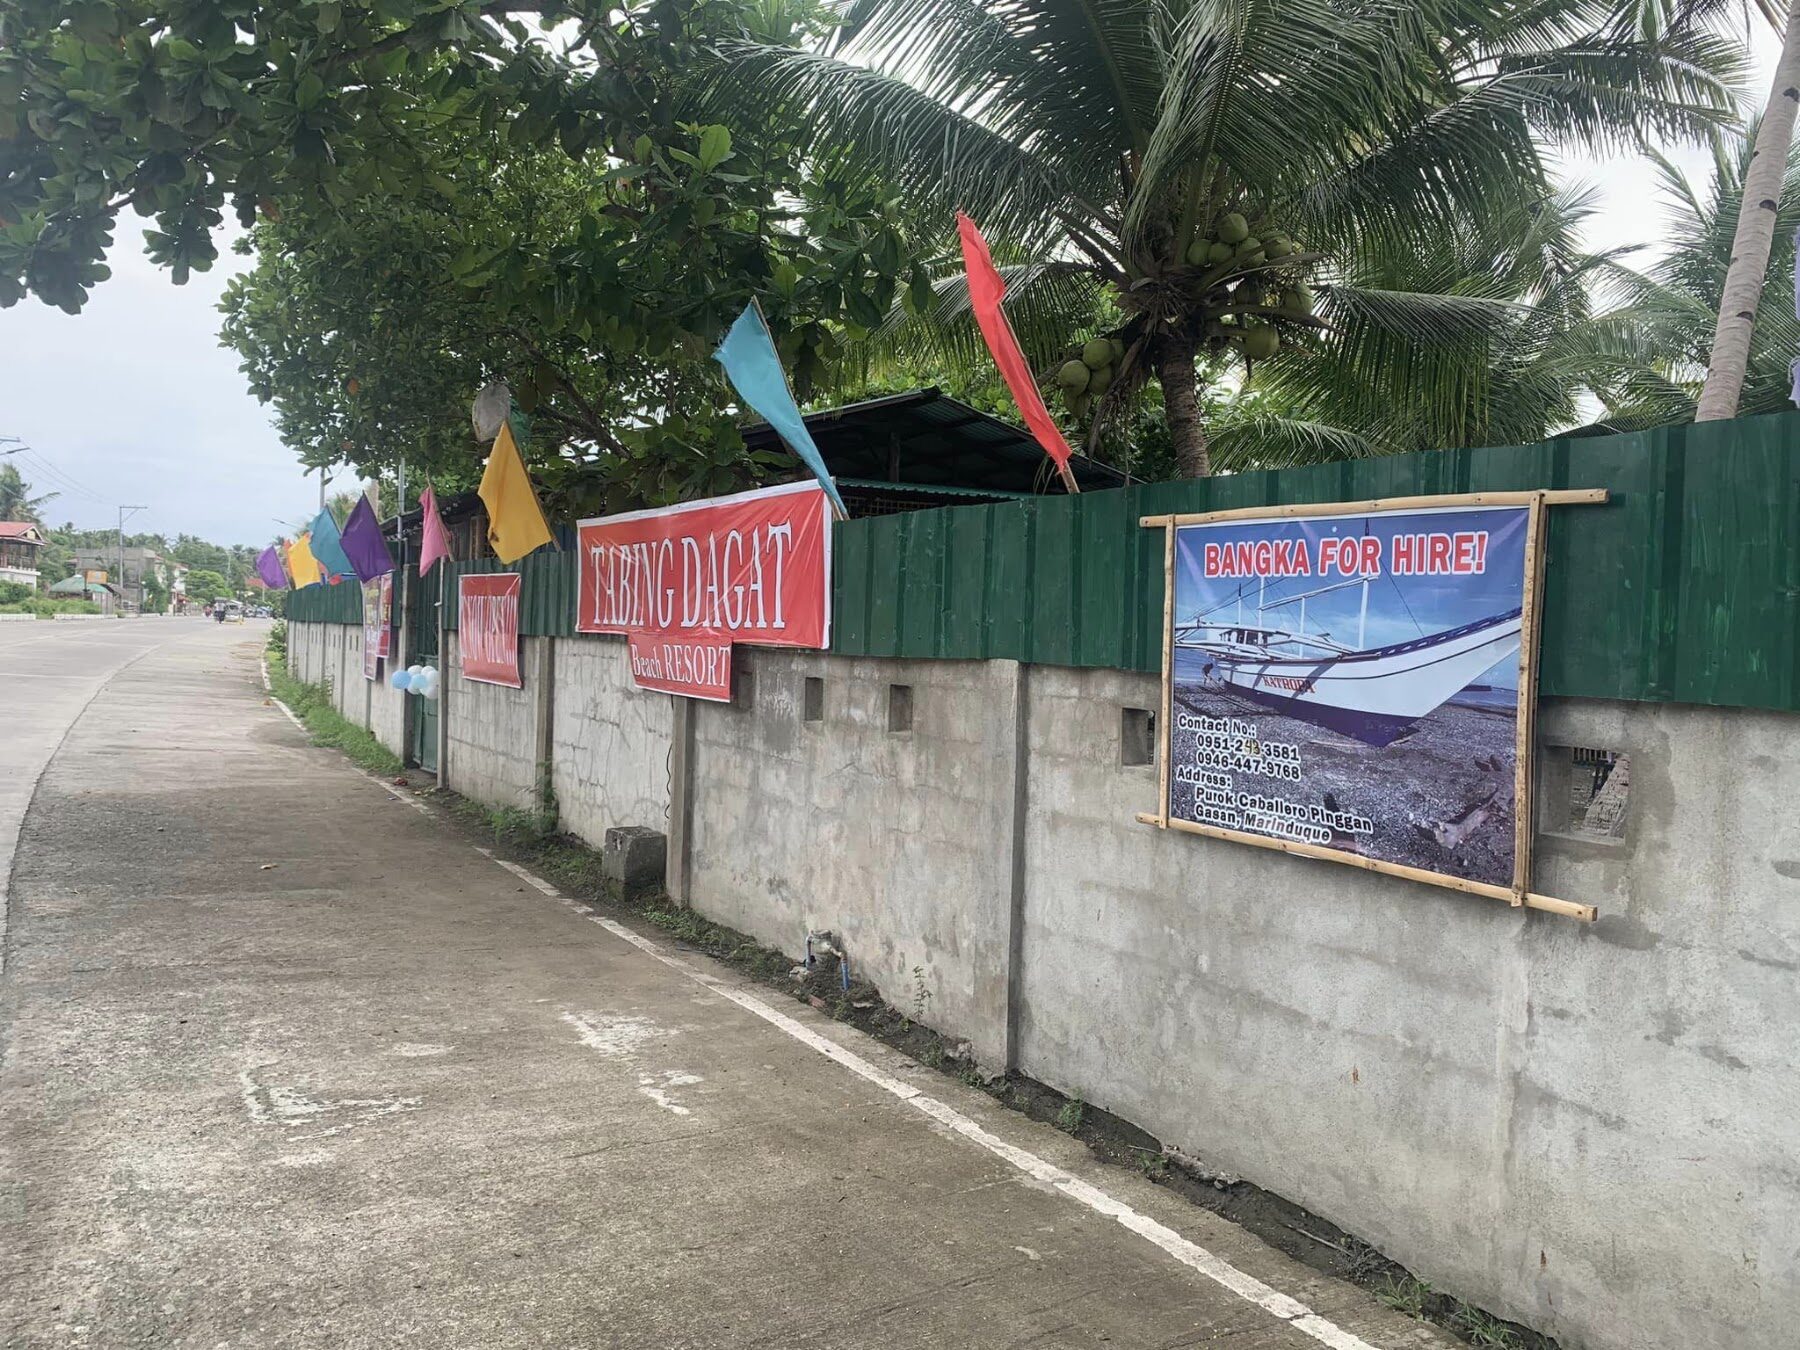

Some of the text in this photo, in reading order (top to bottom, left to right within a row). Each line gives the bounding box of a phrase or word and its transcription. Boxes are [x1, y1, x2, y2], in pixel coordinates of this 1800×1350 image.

[591, 518, 792, 630] TABING DAGAT
[1204, 531, 1489, 578] BANGKA FOR HIRE!
[631, 644, 731, 687] Beach RESORT
[1178, 714, 1257, 738] Contact No.:
[1176, 766, 1232, 788] Address:
[1197, 751, 1300, 780] 0946-447-9768
[1194, 804, 1332, 844] Gasan, Marinduque
[1195, 786, 1374, 833] Purok Caballero Pinggan
